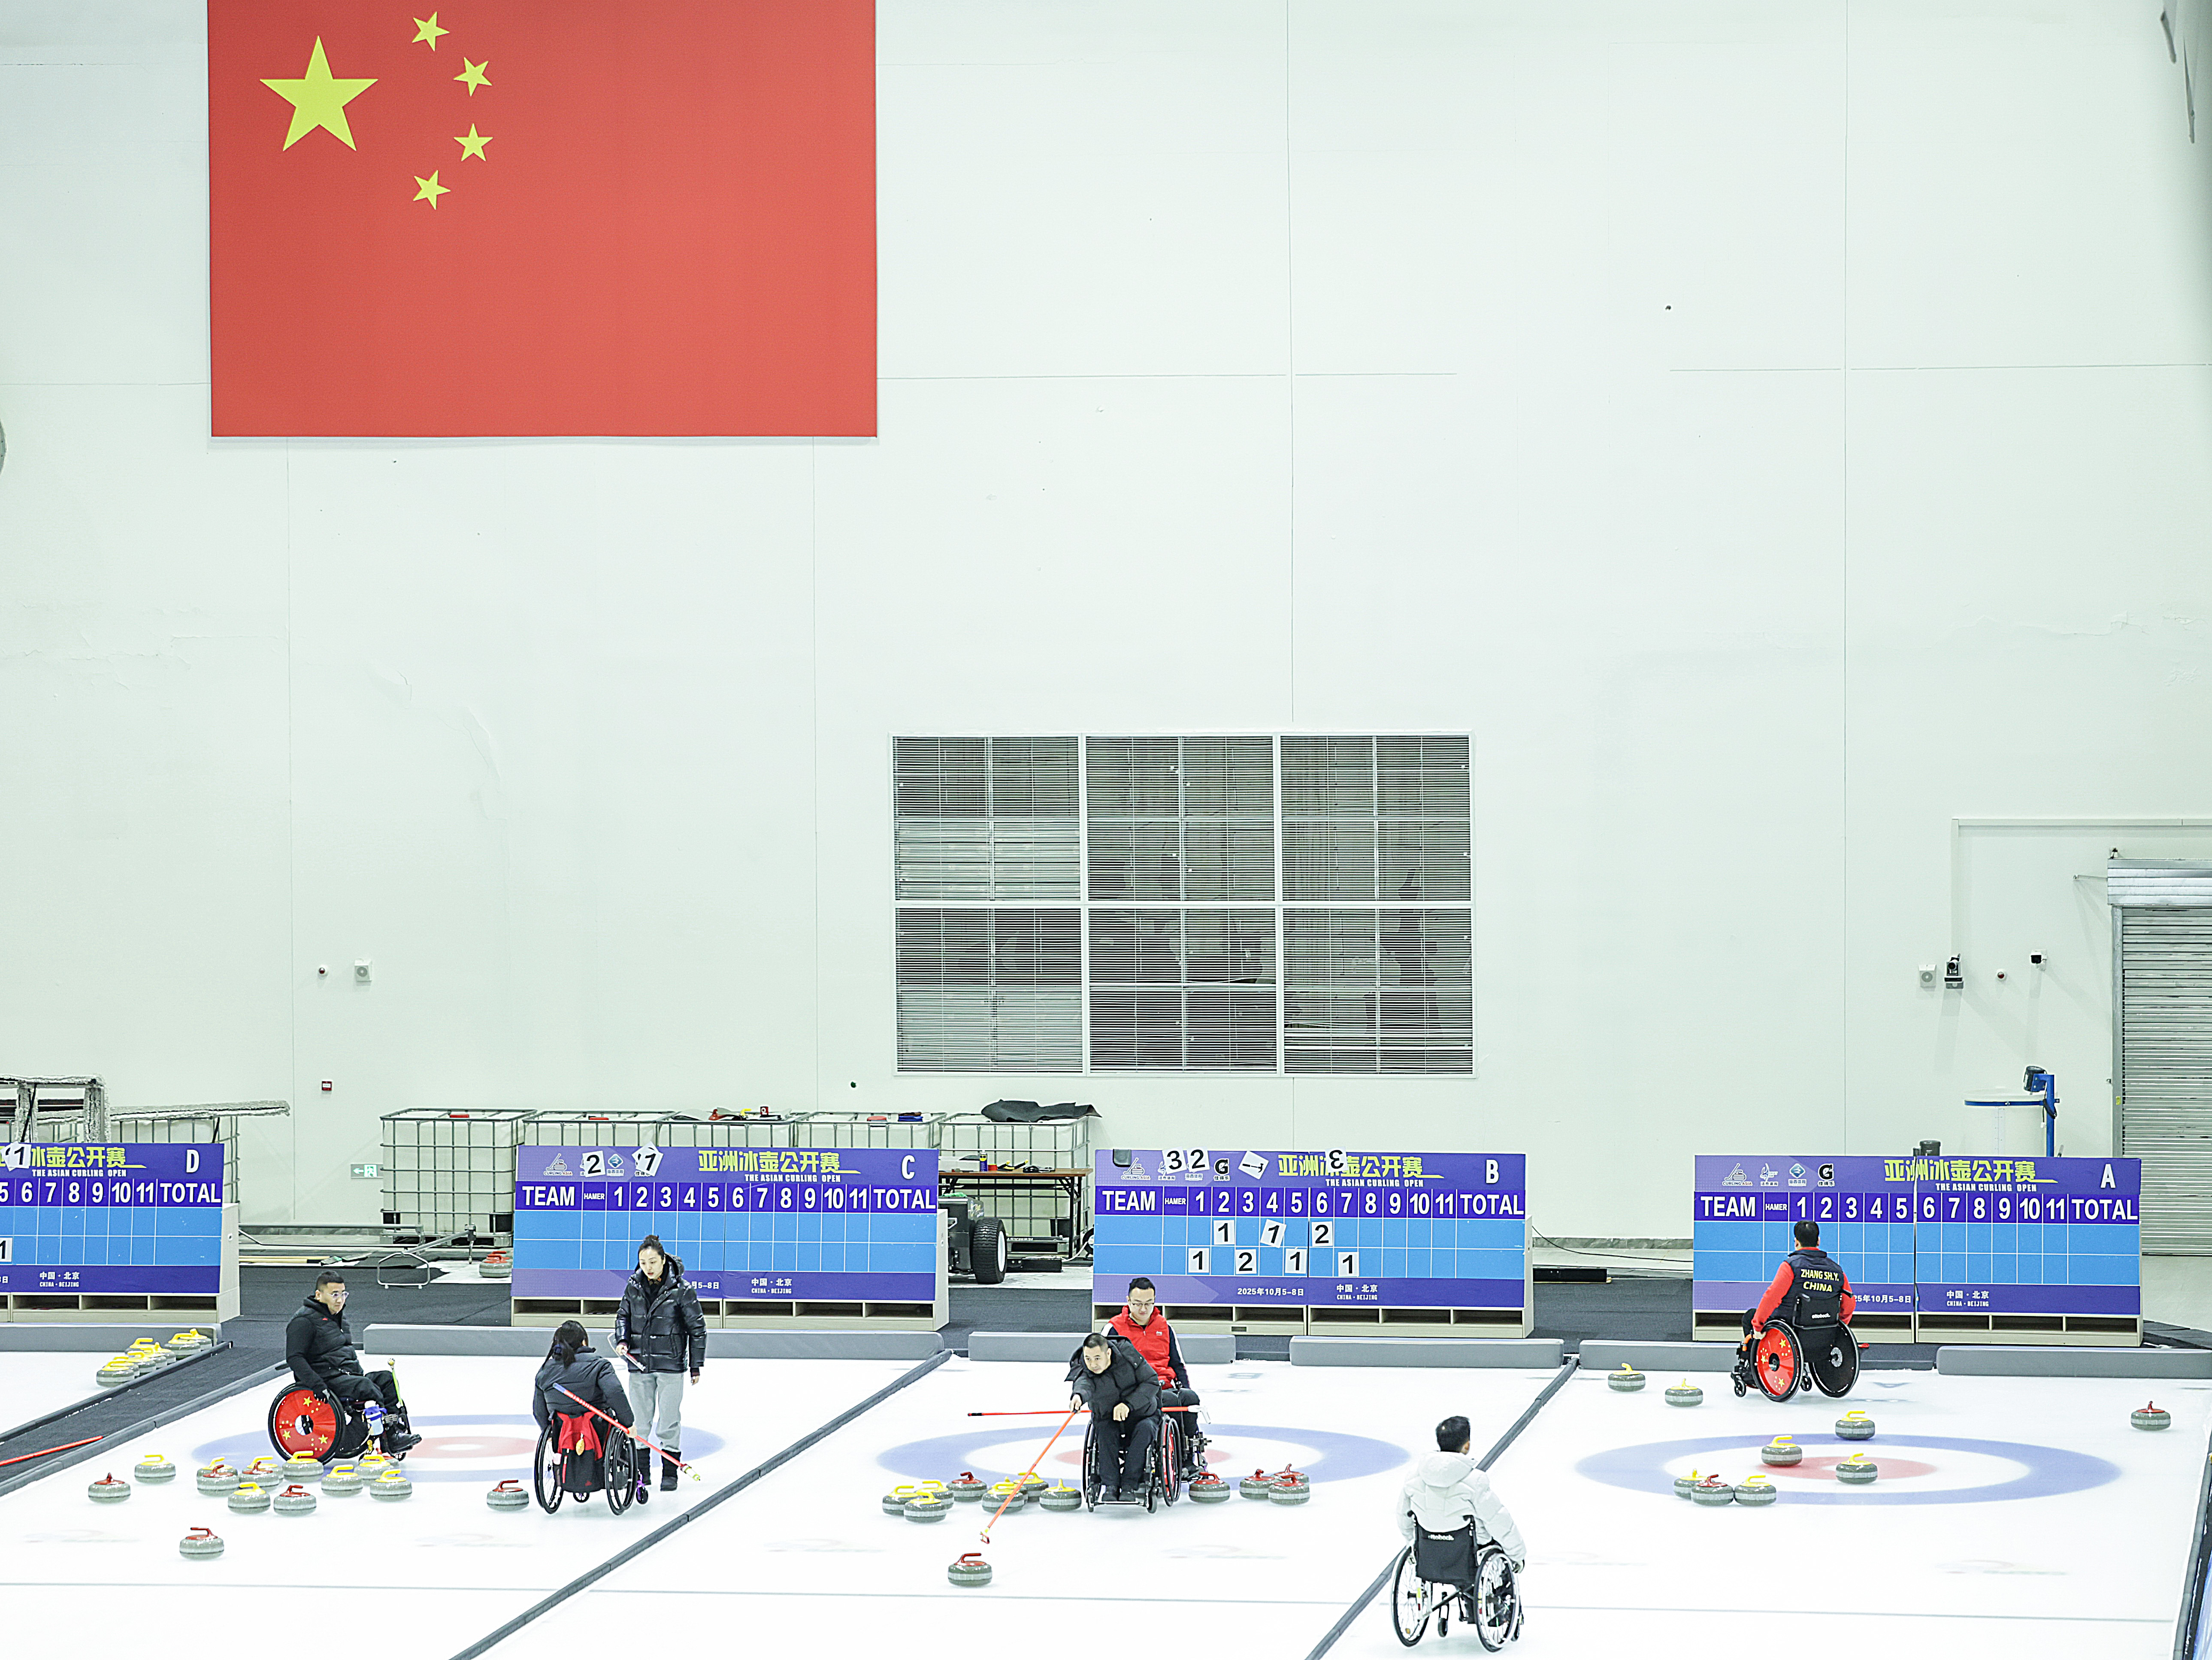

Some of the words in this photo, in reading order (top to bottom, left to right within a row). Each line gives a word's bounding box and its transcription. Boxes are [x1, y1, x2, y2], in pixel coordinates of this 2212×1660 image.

[15, 1147, 24, 1165] 1
[187, 1150, 199, 1172] D
[587, 1155, 601, 1174] 2
[699, 1151, 840, 1173] 亚洲冰壶公开赛
[902, 1155, 914, 1179] C
[1167, 1151, 1182, 1169] 3
[1191, 1150, 1205, 1169] 2
[1486, 1160, 1498, 1183] B
[1884, 1159, 2035, 1182] 亚洲冰壶公开赛
[2101, 1164, 2115, 1188] A
[0, 1182, 8, 1202] 5
[22, 1182, 32, 1202] 6
[46, 1183, 56, 1202] 7
[69, 1182, 79, 1203] 8
[93, 1182, 103, 1203] 9
[112, 1182, 130, 1203] 10
[136, 1183, 153, 1203] 11
[160, 1183, 221, 1203] TOTAL
[522, 1186, 574, 1206] TEAM
[614, 1187, 622, 1206] 1
[636, 1187, 647, 1207] 2
[660, 1187, 671, 1207] 3
[684, 1187, 695, 1207] 4
[708, 1187, 718, 1207] 5
[733, 1187, 743, 1208] 6
[757, 1188, 767, 1208] 7
[781, 1188, 791, 1208] 8
[805, 1188, 815, 1209] 9
[824, 1188, 843, 1209] 10
[850, 1188, 866, 1209] 11
[874, 1189, 935, 1209] TOTAL
[1102, 1191, 1155, 1210] TEAM
[1196, 1191, 1204, 1212] 1
[1219, 1192, 1229, 1212] 2
[1243, 1192, 1253, 1212] 3
[1267, 1192, 1278, 1212] 4
[1291, 1193, 1302, 1213] 5
[1317, 1192, 1327, 1213] 6
[1341, 1193, 1352, 1213] 7
[1365, 1193, 1376, 1213] 8
[1390, 1193, 1400, 1214] 9
[1410, 1194, 1429, 1214] 10
[1436, 1194, 1453, 1214] 11
[1460, 1194, 1524, 1215] TOTAL
[1701, 1197, 1755, 1216] TEAM
[1797, 1197, 1805, 1217] 1
[1821, 1197, 1831, 1218] 2
[1846, 1197, 1857, 1218] 3
[1870, 1198, 1882, 1218] 4
[1896, 1198, 1907, 1218] 5
[1924, 1197, 1934, 1218] 6
[1949, 1198, 1959, 1218] 7
[1974, 1198, 1985, 1218] 8
[1999, 1198, 2010, 1219] 9
[2020, 1198, 2040, 1219] 10
[2046, 1199, 2064, 1219] 11
[2072, 1199, 2137, 1220] TOTAL
[1219, 1223, 1228, 1242] 1
[1268, 1225, 1279, 1243] 1
[1315, 1225, 1328, 1243] 2
[1193, 1251, 1202, 1269] 1
[1239, 1252, 1252, 1271] 2
[1290, 1252, 1300, 1270] 1
[1343, 1255, 1352, 1273] 1
[1801, 1269, 1823, 1279] ZHANG
[1824, 1271, 1839, 1281] SH.Y.
[1803, 1281, 1832, 1292] CHINA
